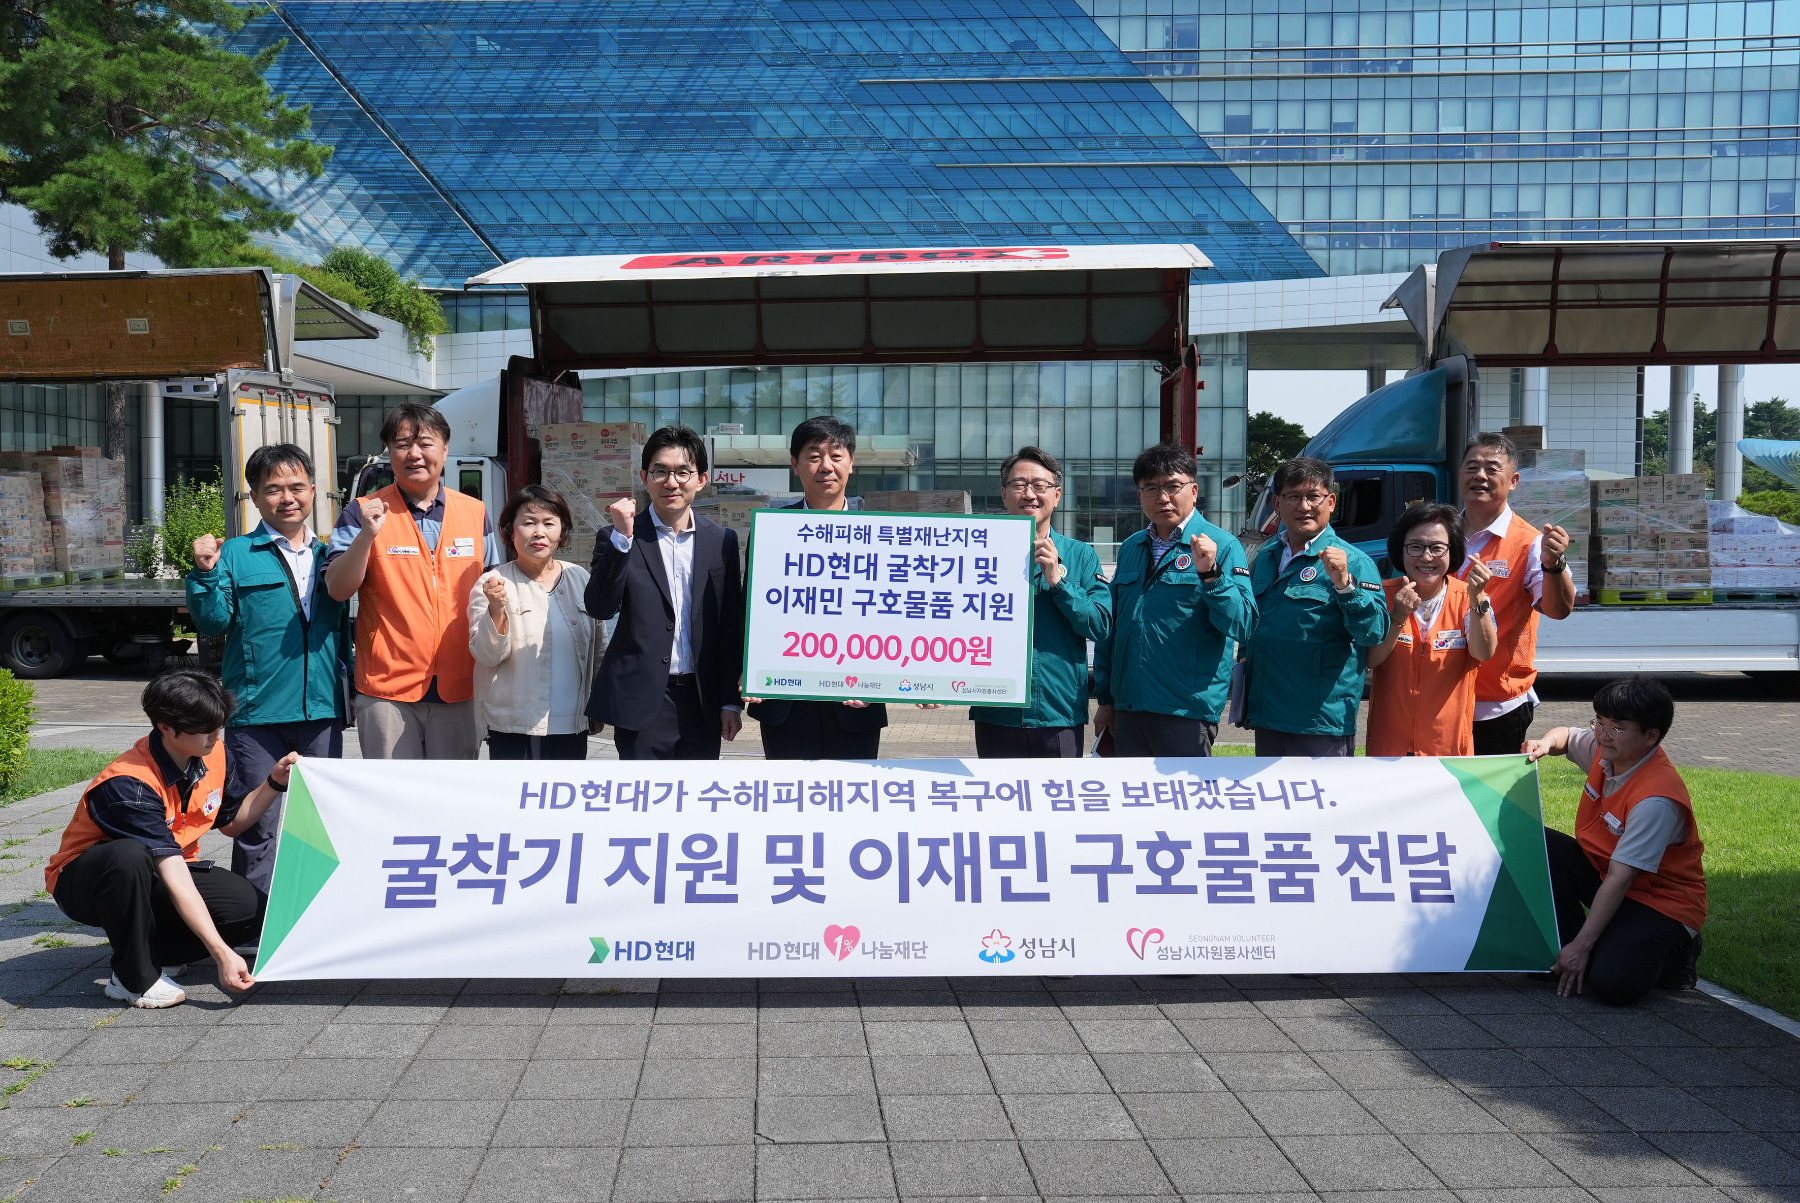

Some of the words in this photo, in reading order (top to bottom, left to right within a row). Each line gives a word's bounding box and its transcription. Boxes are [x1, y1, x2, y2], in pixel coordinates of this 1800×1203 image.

[797, 524, 872, 544] 수해피해
[877, 526, 988, 548] 특별재난지역
[784, 552, 878, 581] HD현대
[886, 554, 964, 584] 굴착기
[974, 557, 998, 585] 및
[765, 586, 843, 615] 이재민
[852, 589, 954, 619] 구호물품
[962, 592, 1014, 621] 지원
[782, 631, 992, 668] 200,000,000원
[774, 677, 802, 687] HD현대
[819, 680, 845, 688] HD현대
[912, 682, 934, 691] 성남시
[519, 780, 689, 813] HD현대가
[697, 780, 916, 813] 수해피해지역
[927, 779, 1032, 812] 복구에
[1041, 779, 1111, 812] 힘을
[1121, 779, 1338, 811] 보태겠습니다.
[381, 832, 584, 909] 굴착기
[603, 832, 739, 905] 지원
[765, 832, 827, 905] 및
[848, 831, 1051, 904] 이재민
[1070, 831, 1321, 905] 구호물품
[1335, 831, 1458, 905] 전달
[1018, 937, 1076, 960] 성남시
[1188, 934, 1231, 943] SEONGNAM
[1232, 934, 1276, 943] VOLUNTEER
[614, 940, 695, 962] HD현대
[747, 941, 820, 961] HD현대
[861, 940, 929, 960] 나눔재단
[1156, 945, 1276, 961] 성남시자원봉사센터
